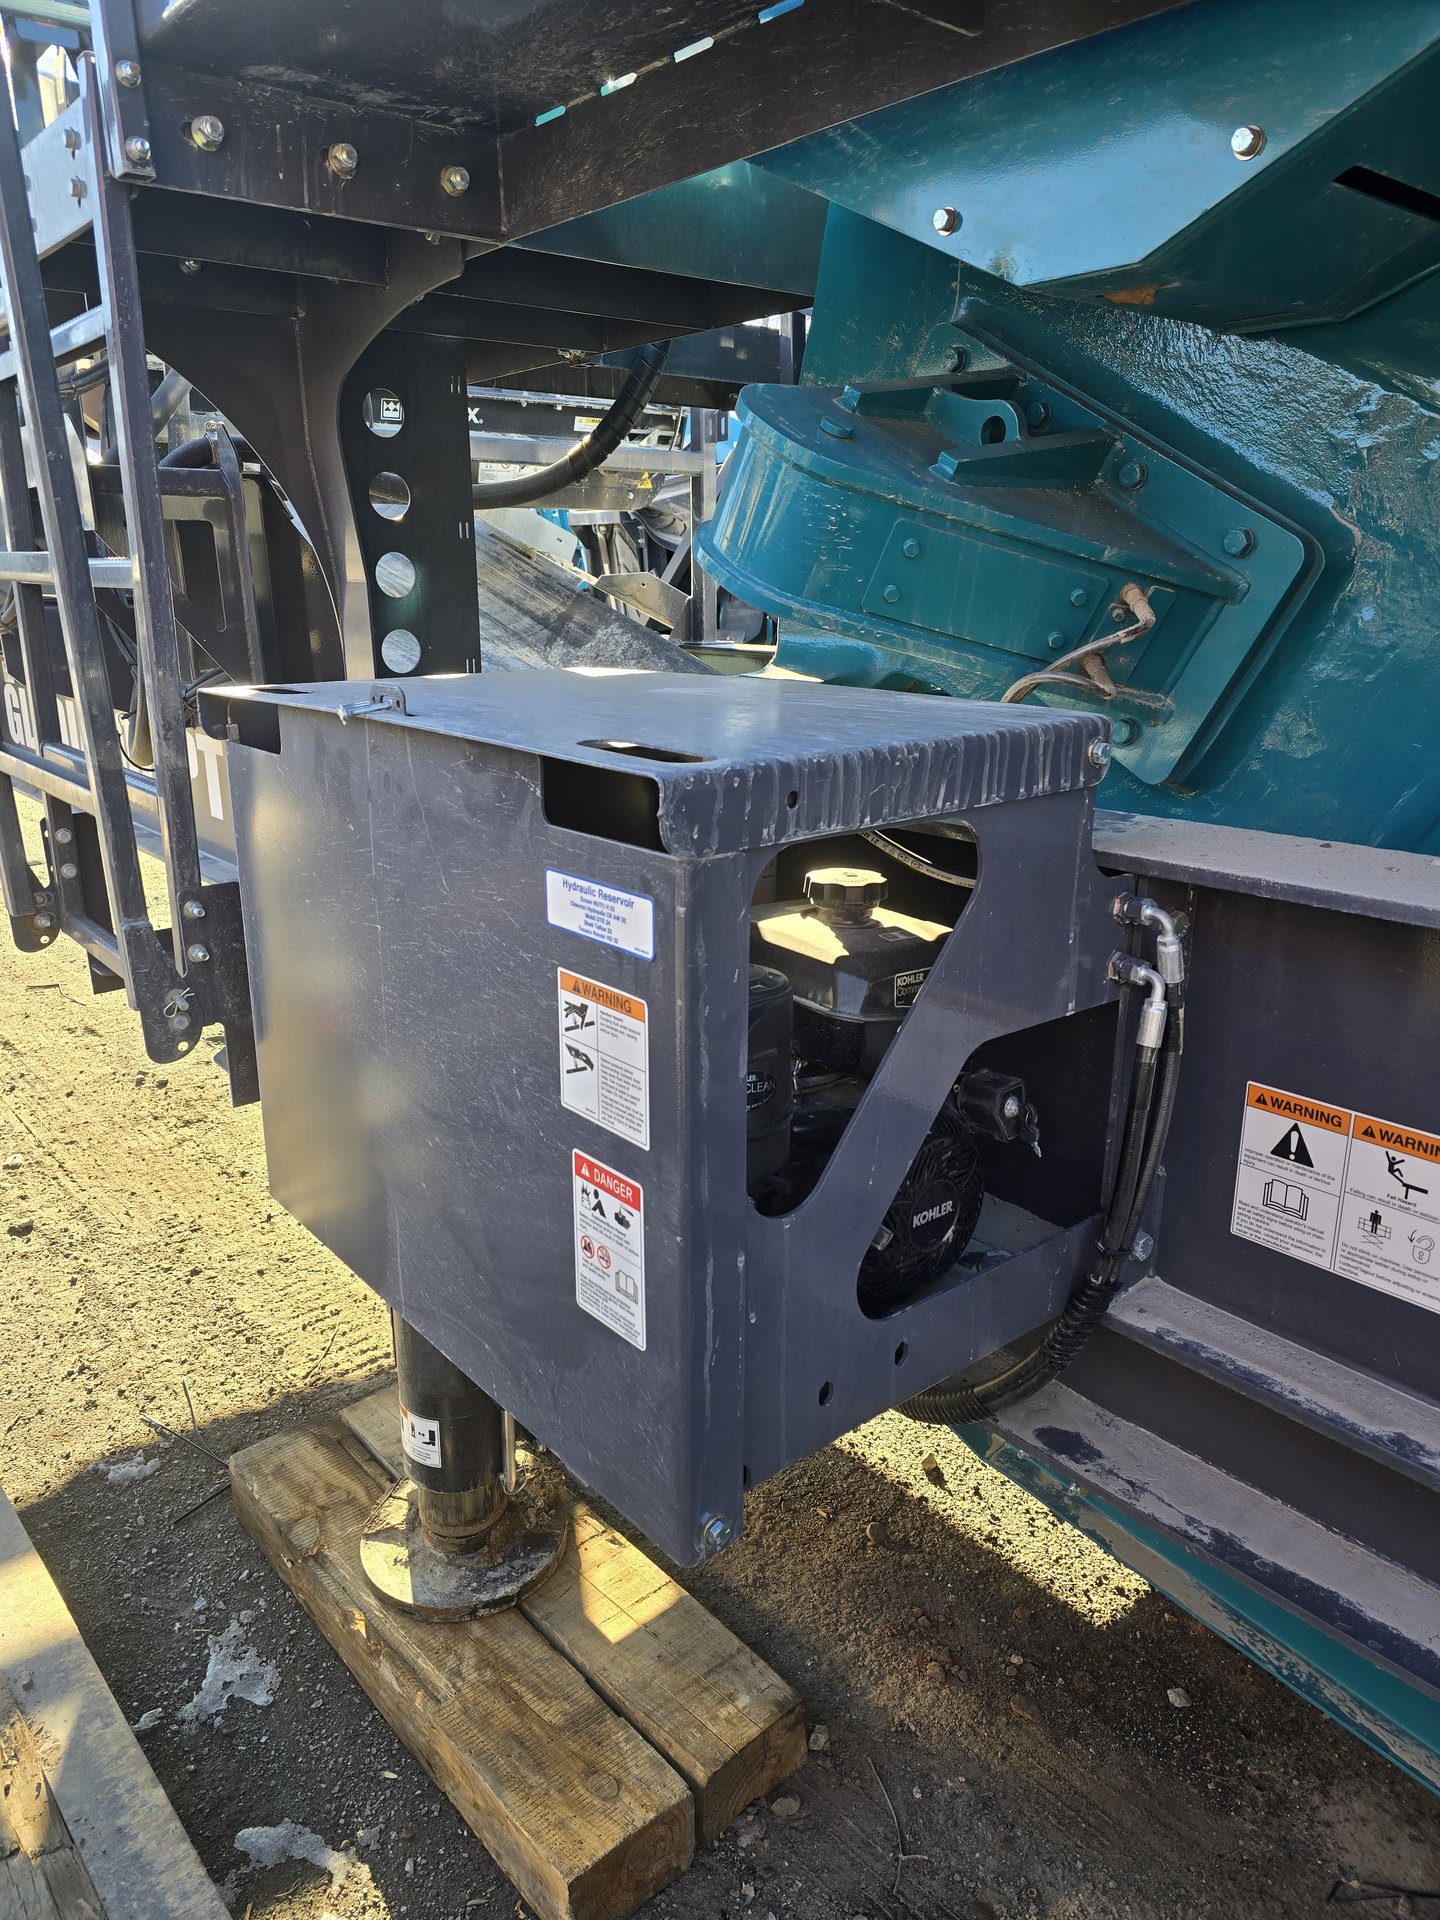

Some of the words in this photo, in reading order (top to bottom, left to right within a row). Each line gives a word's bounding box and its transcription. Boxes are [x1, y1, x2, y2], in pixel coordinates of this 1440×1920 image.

[562, 878, 596, 899] Hydraulic
[598, 889, 634, 909] Reservoir
[896, 985, 920, 997] Comm
[897, 972, 924, 987] KOHLER
[582, 982, 632, 1014] WARNING
[746, 1074, 757, 1082] LER
[1270, 1096, 1343, 1128] WARNING
[1244, 1153, 1266, 1165] equipment
[1276, 1164, 1289, 1172] result
[1295, 1170, 1307, 1178] death
[1314, 1176, 1331, 1186] serious
[1245, 1147, 1264, 1158] Improper
[1265, 1155, 1285, 1165] operation
[1292, 1163, 1320, 1176] maintenance
[594, 1167, 633, 1203] DANGER
[912, 1200, 954, 1228] KOHLER
[1387, 1193, 1396, 1201] Fall
[1398, 1197, 1417, 1208] Hazard
[1238, 1200, 1250, 1208] Read
[1260, 1207, 1283, 1220] understand
[1285, 1217, 1306, 1229] operator's
[1308, 1225, 1324, 1235] manual
[1263, 1226, 1287, 1239] understand
[1296, 1238, 1321, 1251] information
